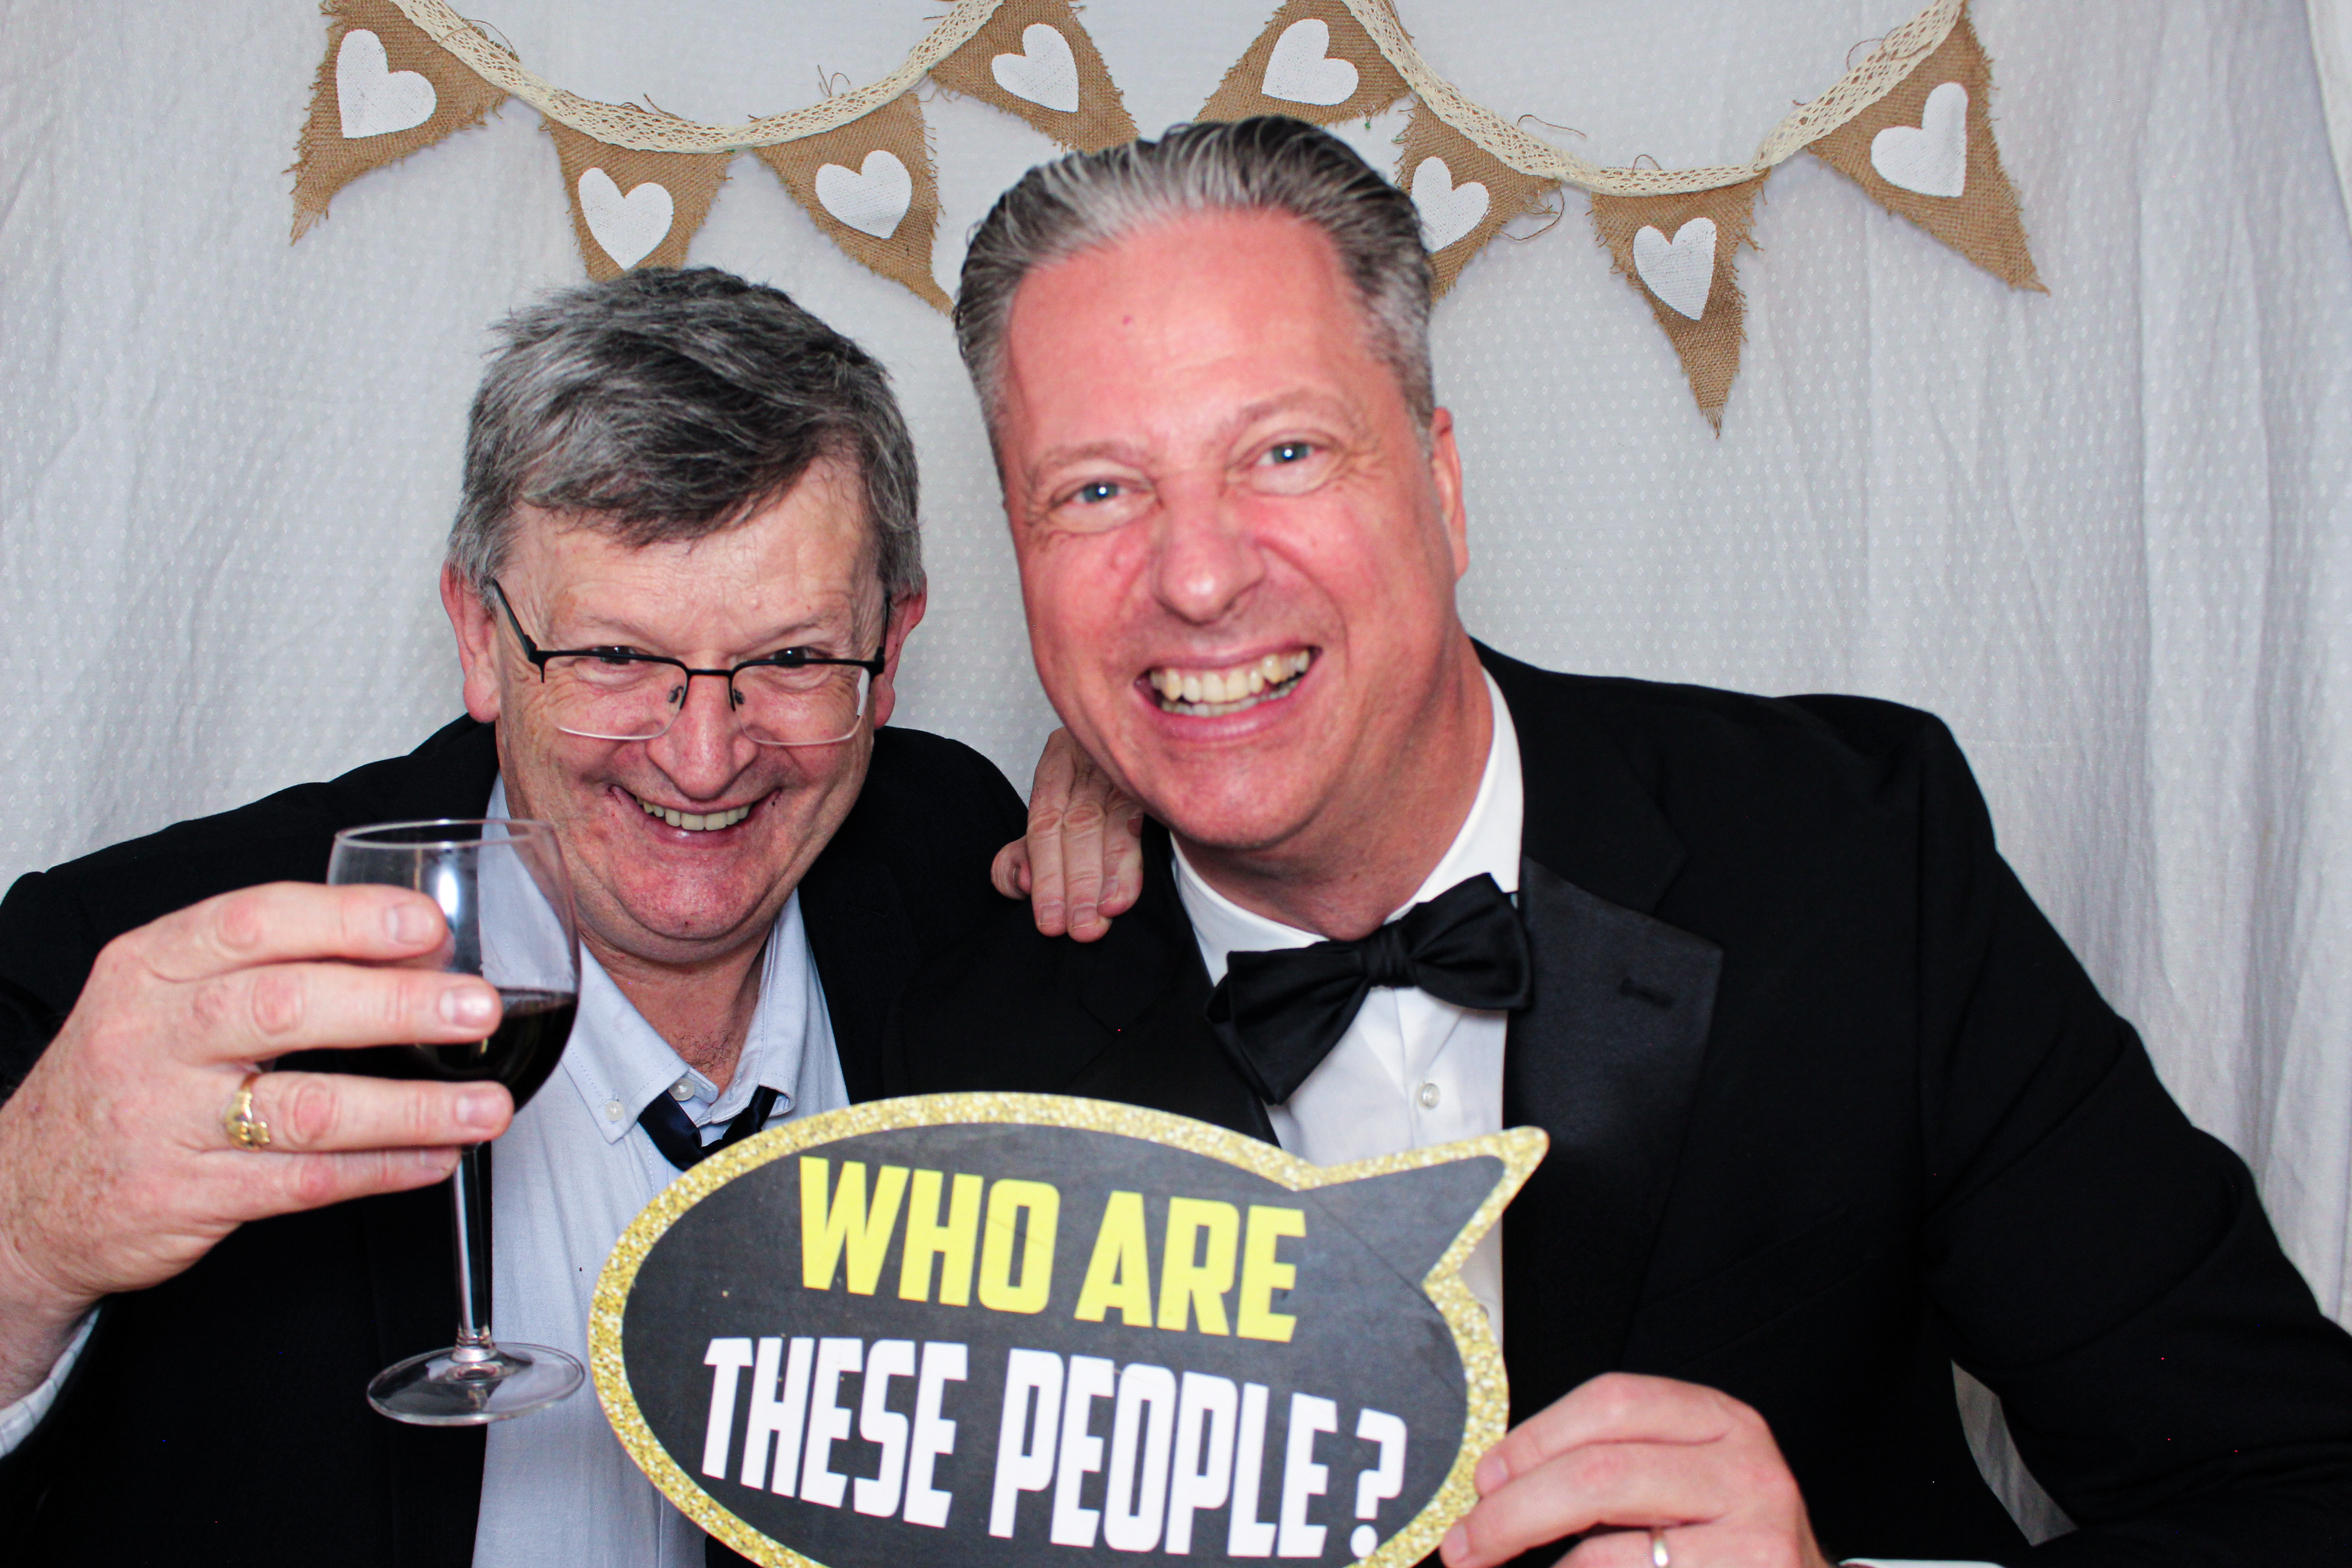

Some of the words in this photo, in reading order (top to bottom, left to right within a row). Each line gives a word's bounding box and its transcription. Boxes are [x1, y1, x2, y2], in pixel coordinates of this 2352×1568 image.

[800, 1156, 1061, 1314] WHO
[1073, 1190, 1307, 1343] ARE
[702, 1337, 968, 1528] THESE
[989, 1348, 1407, 1558] PEOPLE?
